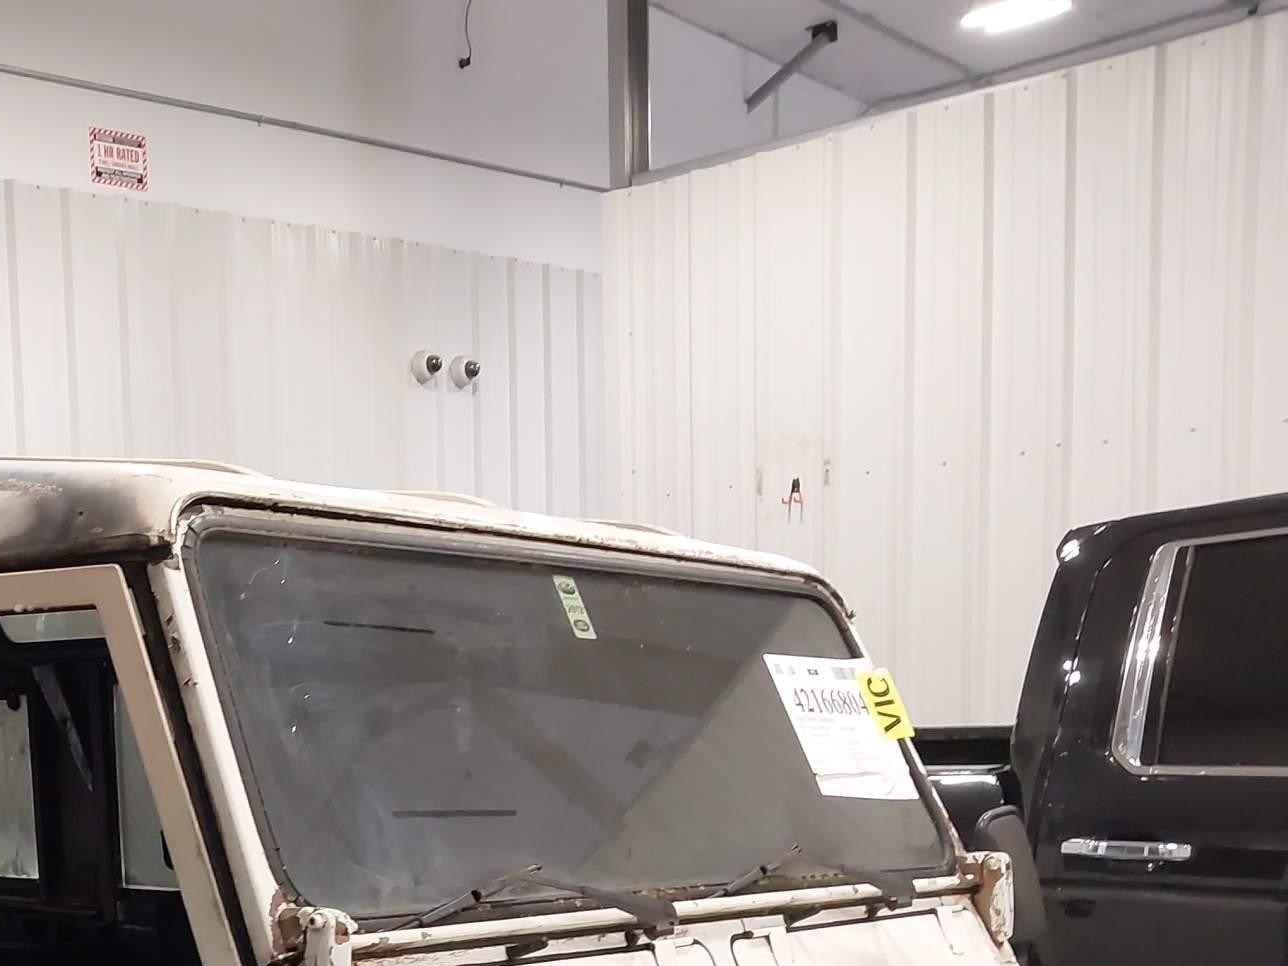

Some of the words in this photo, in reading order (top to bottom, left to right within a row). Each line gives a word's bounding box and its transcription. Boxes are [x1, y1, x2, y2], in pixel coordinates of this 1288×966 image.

[103, 145, 114, 158] HR
[116, 147, 139, 163] RATED
[867, 677, 902, 733] VIC
